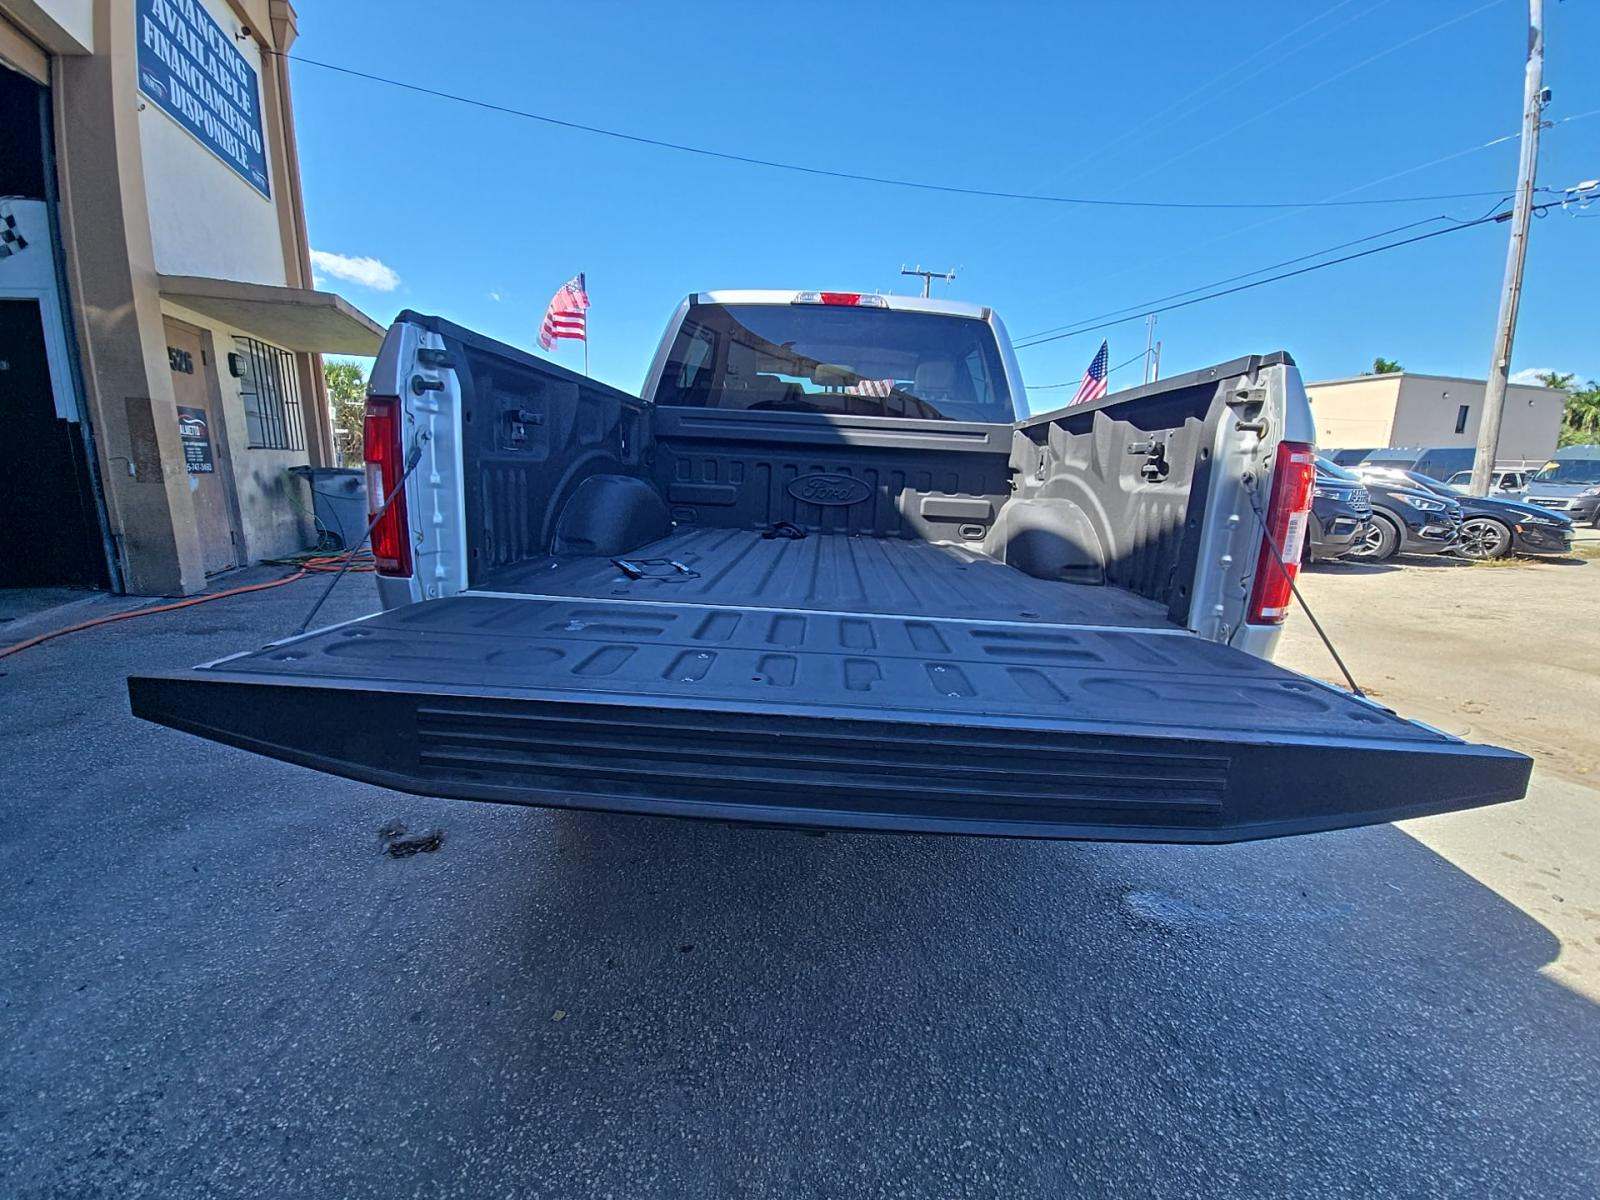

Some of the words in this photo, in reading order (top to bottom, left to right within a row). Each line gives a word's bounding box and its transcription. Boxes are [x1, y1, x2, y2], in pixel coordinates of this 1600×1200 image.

[143, 14, 261, 154] FINANCIAMIENTO
[152, 0, 251, 117] AVAILABLE
[169, 75, 249, 170] DISPONIBLE
[802, 477, 856, 500] Ford
